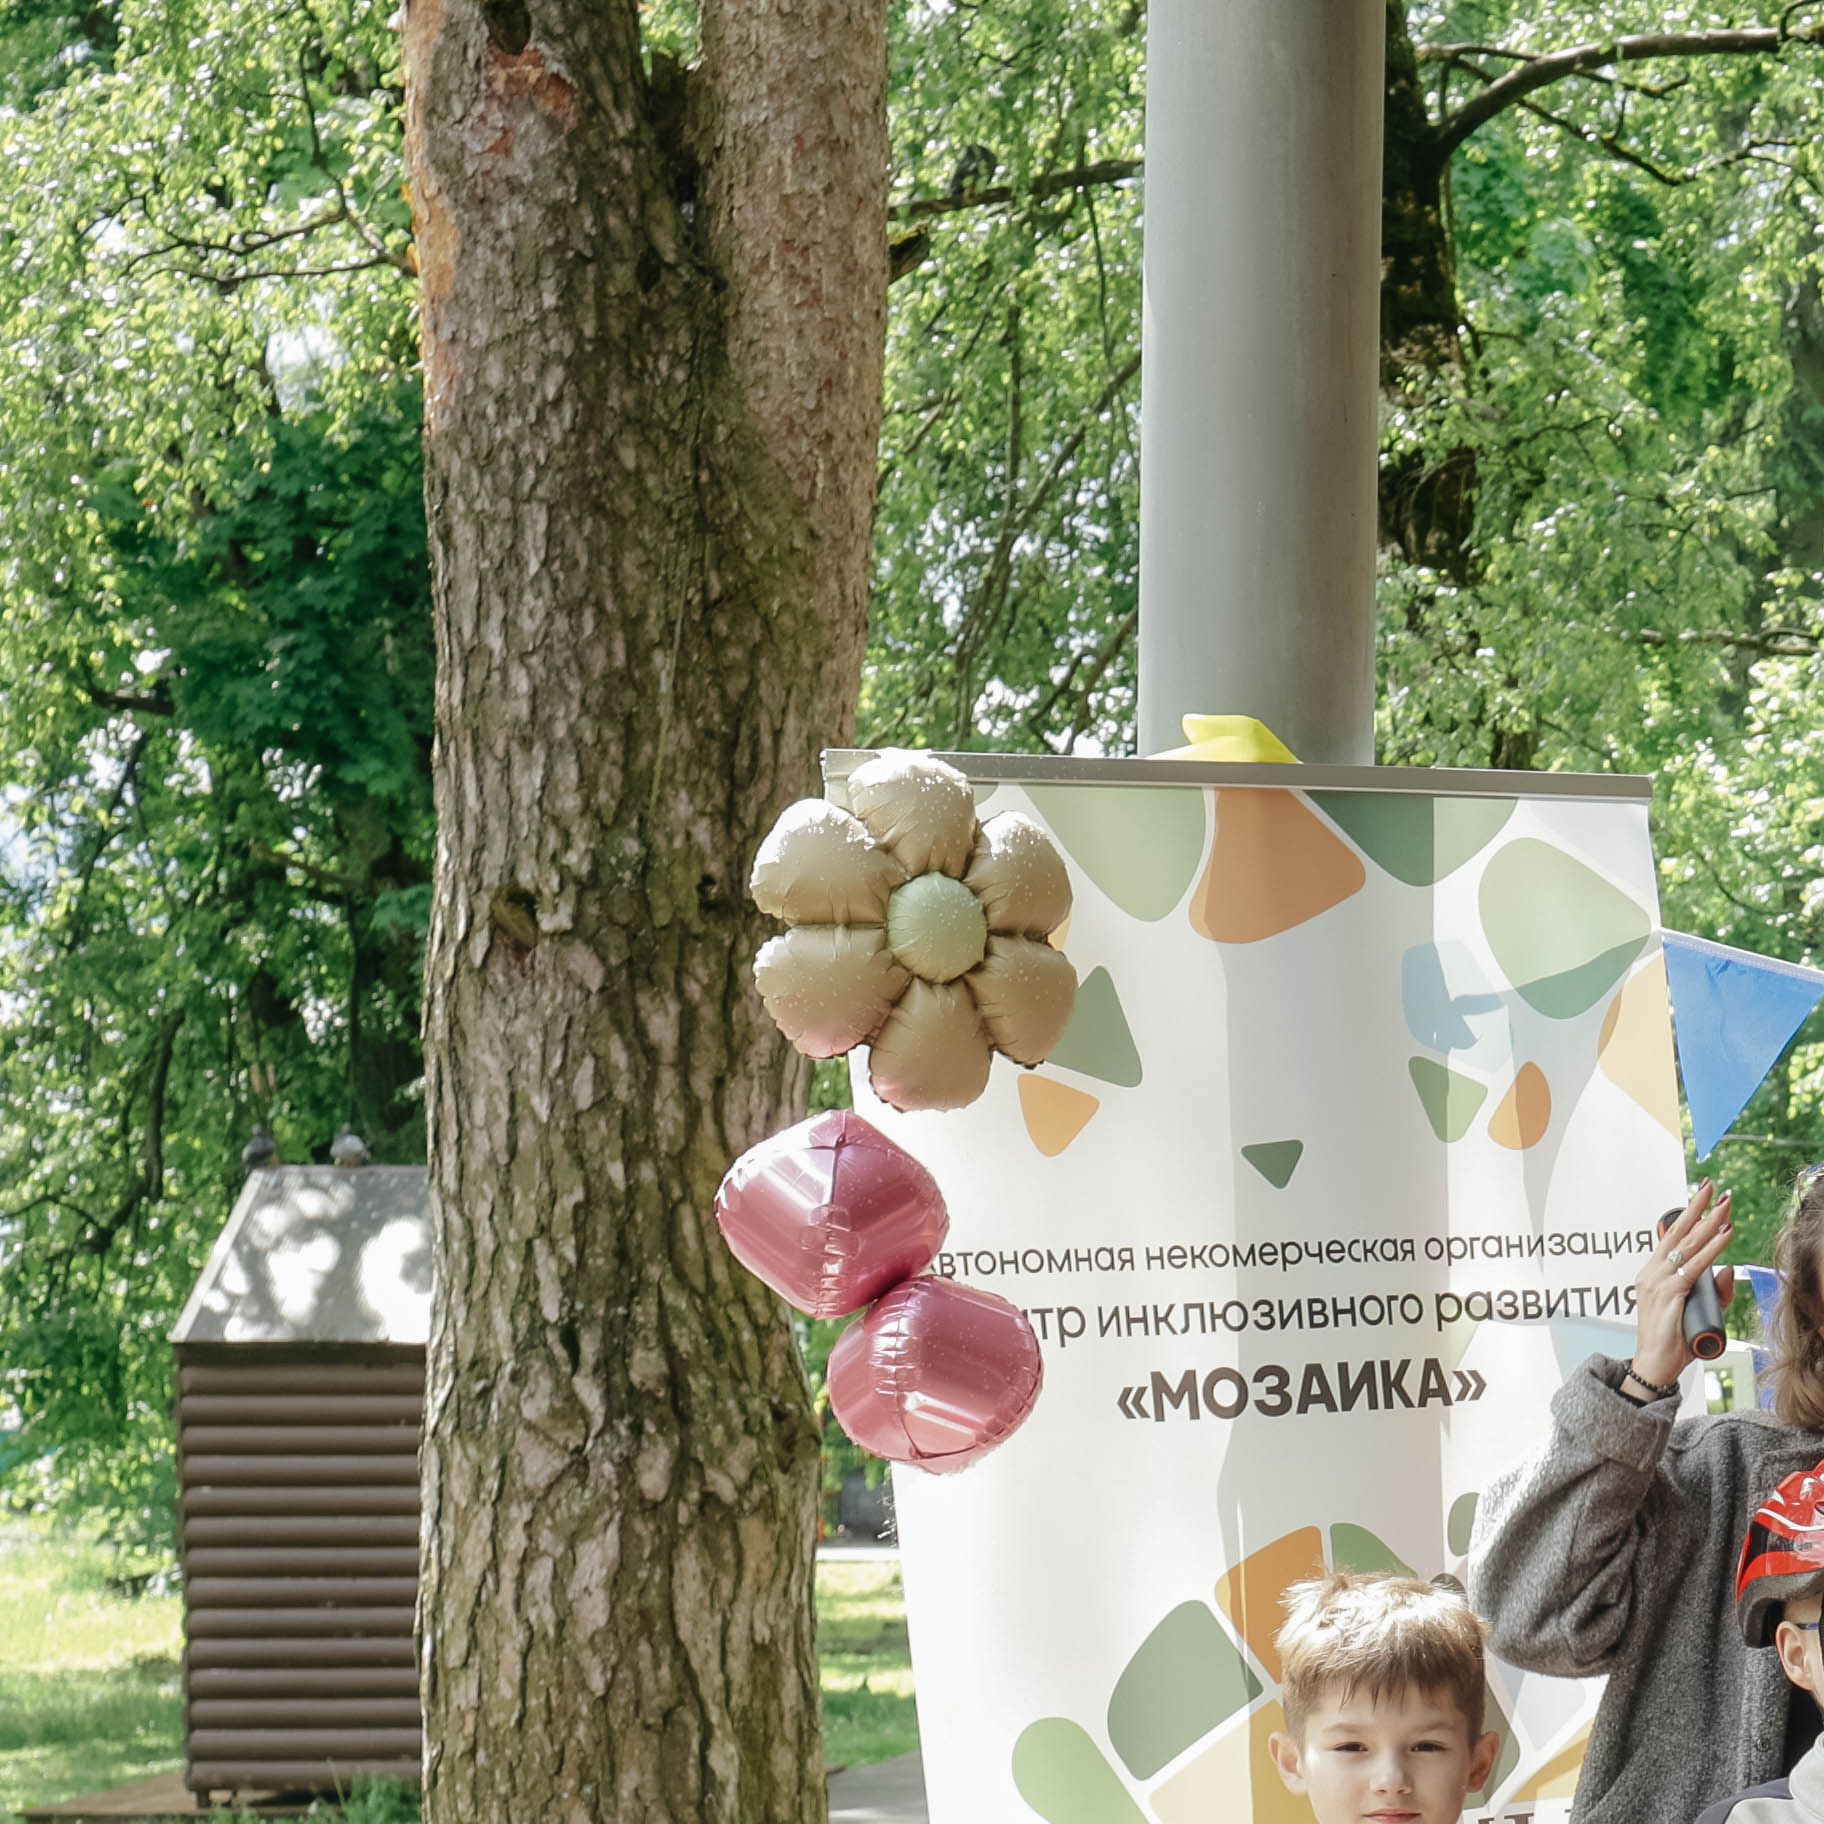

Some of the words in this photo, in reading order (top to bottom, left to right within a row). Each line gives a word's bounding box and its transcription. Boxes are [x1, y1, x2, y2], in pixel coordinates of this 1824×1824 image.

[930, 1246, 1135, 1279] втономная
[1146, 1237, 1416, 1272] некомерческая
[1424, 1229, 1655, 1266] организация
[1098, 1292, 1424, 1338] инклюзивного
[1435, 1285, 1640, 1332] развития
[1117, 1357, 1488, 1422] «МОЗАИКА»
